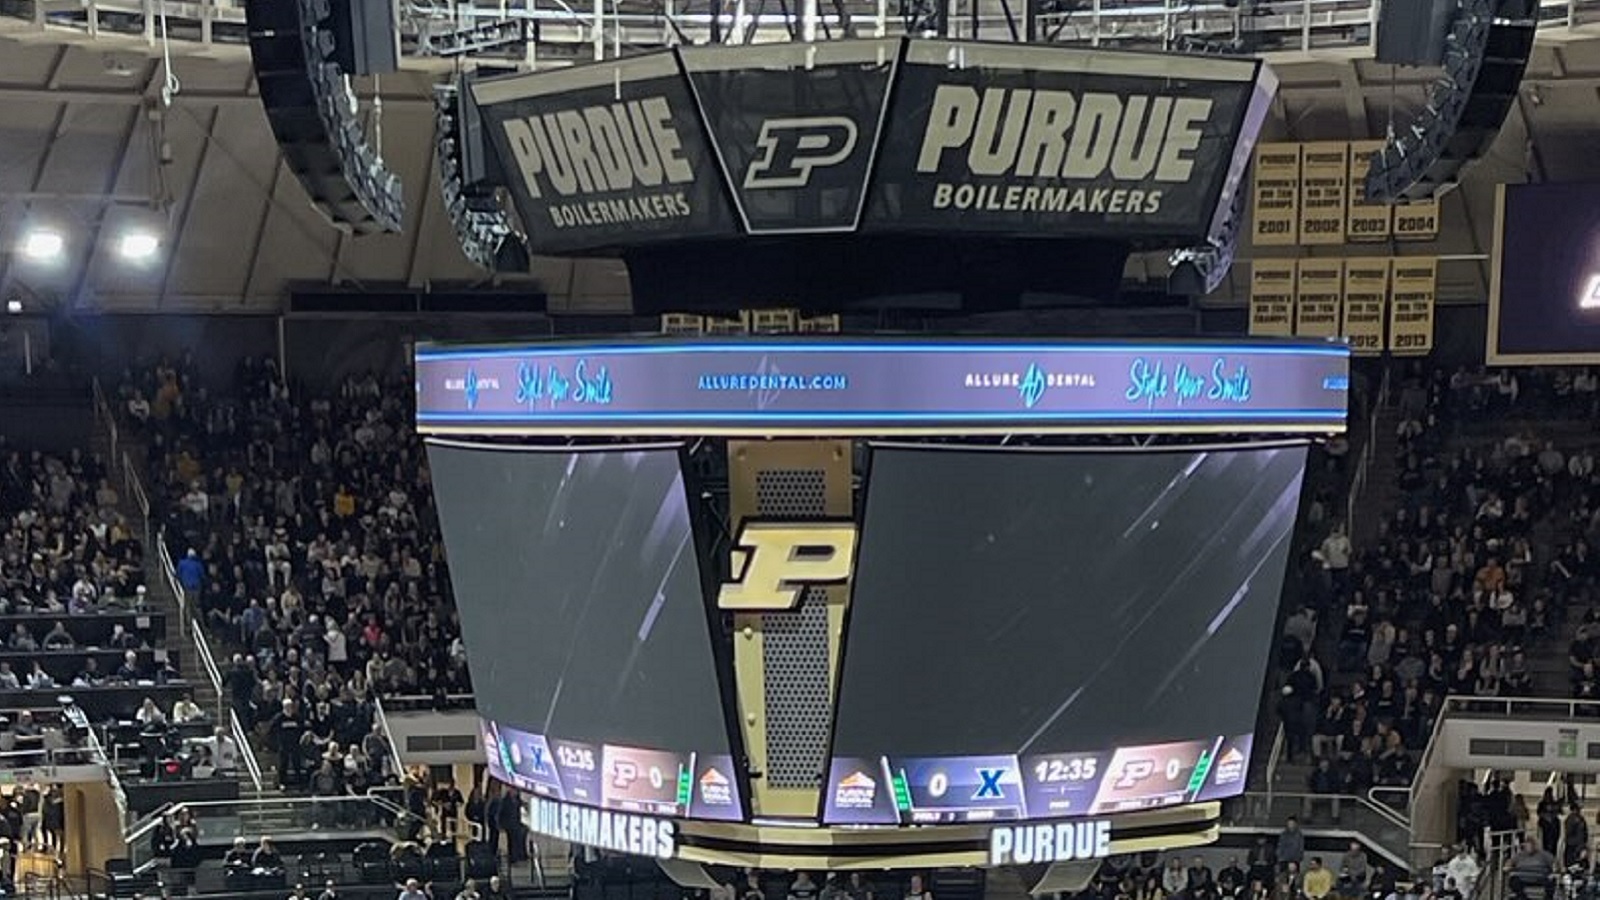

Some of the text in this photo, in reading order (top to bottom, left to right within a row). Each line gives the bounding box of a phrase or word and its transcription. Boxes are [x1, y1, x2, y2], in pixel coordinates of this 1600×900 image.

[917, 85, 1212, 181] PURDUE
[503, 96, 694, 198] PURDUE
[744, 116, 858, 188] P
[550, 193, 690, 227] BOILERMAKERS
[933, 184, 1162, 213] BOILERMAKERS
[1259, 220, 1290, 233] 2001
[1304, 219, 1340, 233] 2002
[1352, 218, 1386, 231] 2003
[1398, 217, 1434, 231] 2004
[1395, 334, 1426, 347] 2013
[572, 358, 613, 404] Smile
[698, 375, 847, 390] ALLUREDENTAL.COM
[965, 373, 1020, 388] ALLURE
[1047, 373, 1096, 387] DENTAL
[1126, 358, 1250, 410] Style Your Smile
[718, 522, 858, 609] P
[557, 745, 595, 771] 12:35
[1035, 758, 1097, 782] 12:35
[1166, 758, 1181, 781] 0
[649, 767, 663, 789] 0
[929, 768, 1007, 800] 0 X
[528, 797, 676, 860] BOILERMAKERS
[990, 820, 1112, 866] PURDUE
